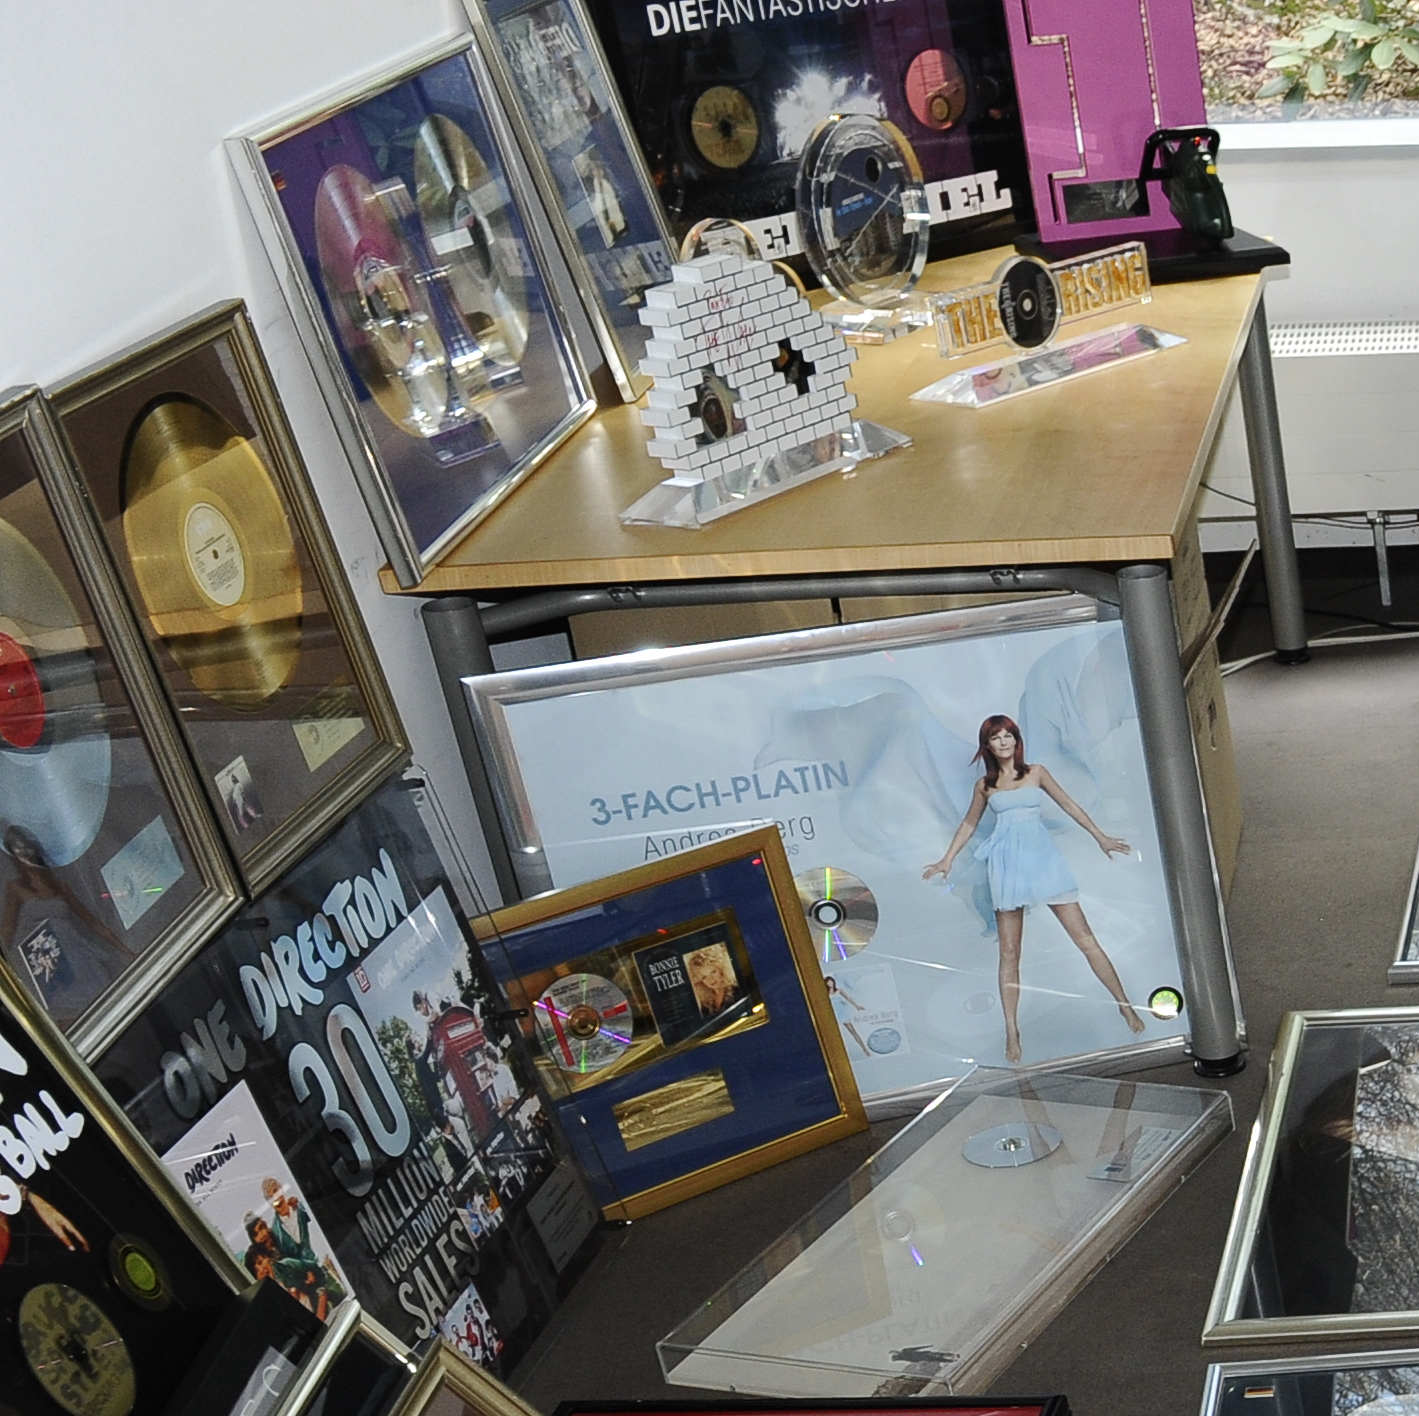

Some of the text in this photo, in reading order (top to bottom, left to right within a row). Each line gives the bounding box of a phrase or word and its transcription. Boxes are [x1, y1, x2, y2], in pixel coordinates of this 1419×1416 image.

[946, 291, 1003, 349] THE
[1058, 250, 1147, 317] RISING
[590, 760, 850, 826] 3-FACH-PLATIN
[240, 847, 408, 1041] DIRECTION
[651, 970, 685, 993] TYLER
[160, 1000, 248, 1121] ONE
[288, 1002, 413, 1199] 30
[355, 1142, 444, 1256] MILLION
[377, 1186, 456, 1286] WORLDWIDE
[398, 1218, 481, 1341] SALES
